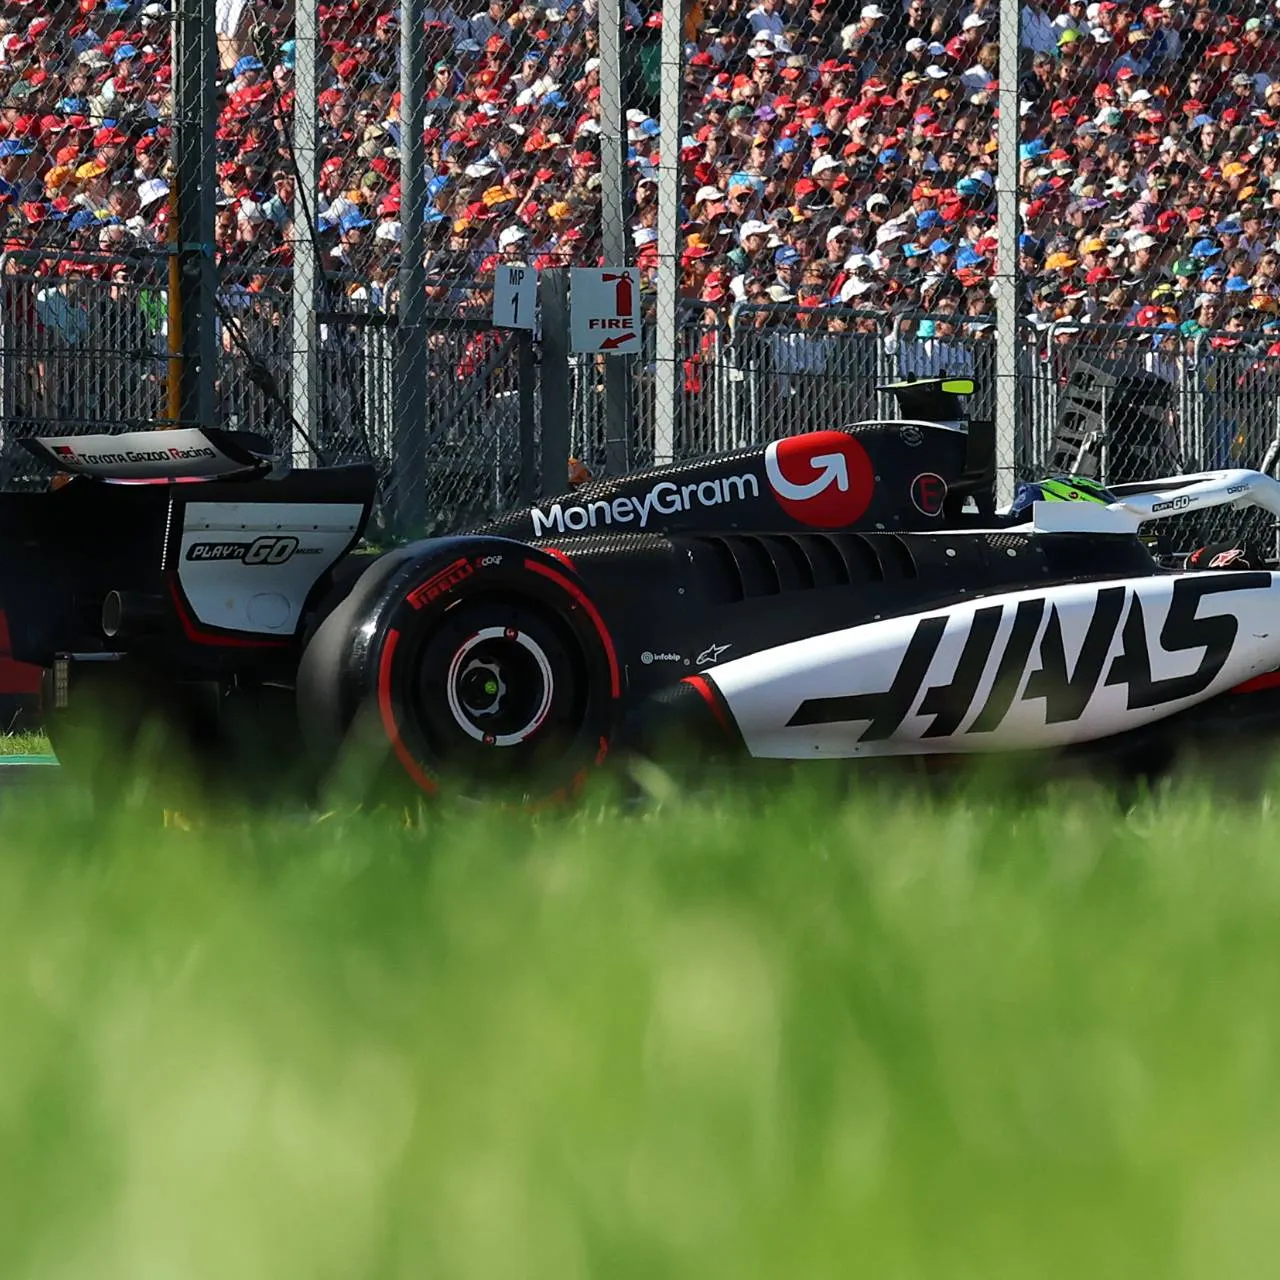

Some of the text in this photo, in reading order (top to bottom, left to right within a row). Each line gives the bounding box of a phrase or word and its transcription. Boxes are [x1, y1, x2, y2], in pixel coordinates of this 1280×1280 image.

[509, 268, 524, 285] MP
[511, 291, 519, 324] 1
[588, 318, 634, 330] FIRE
[126, 451, 169, 465] GAZOO
[167, 446, 216, 460] Racing
[531, 473, 759, 537] MoneyGram
[192, 545, 245, 559] PLAY'n
[244, 537, 298, 565] GO
[654, 653, 680, 662] infobip
